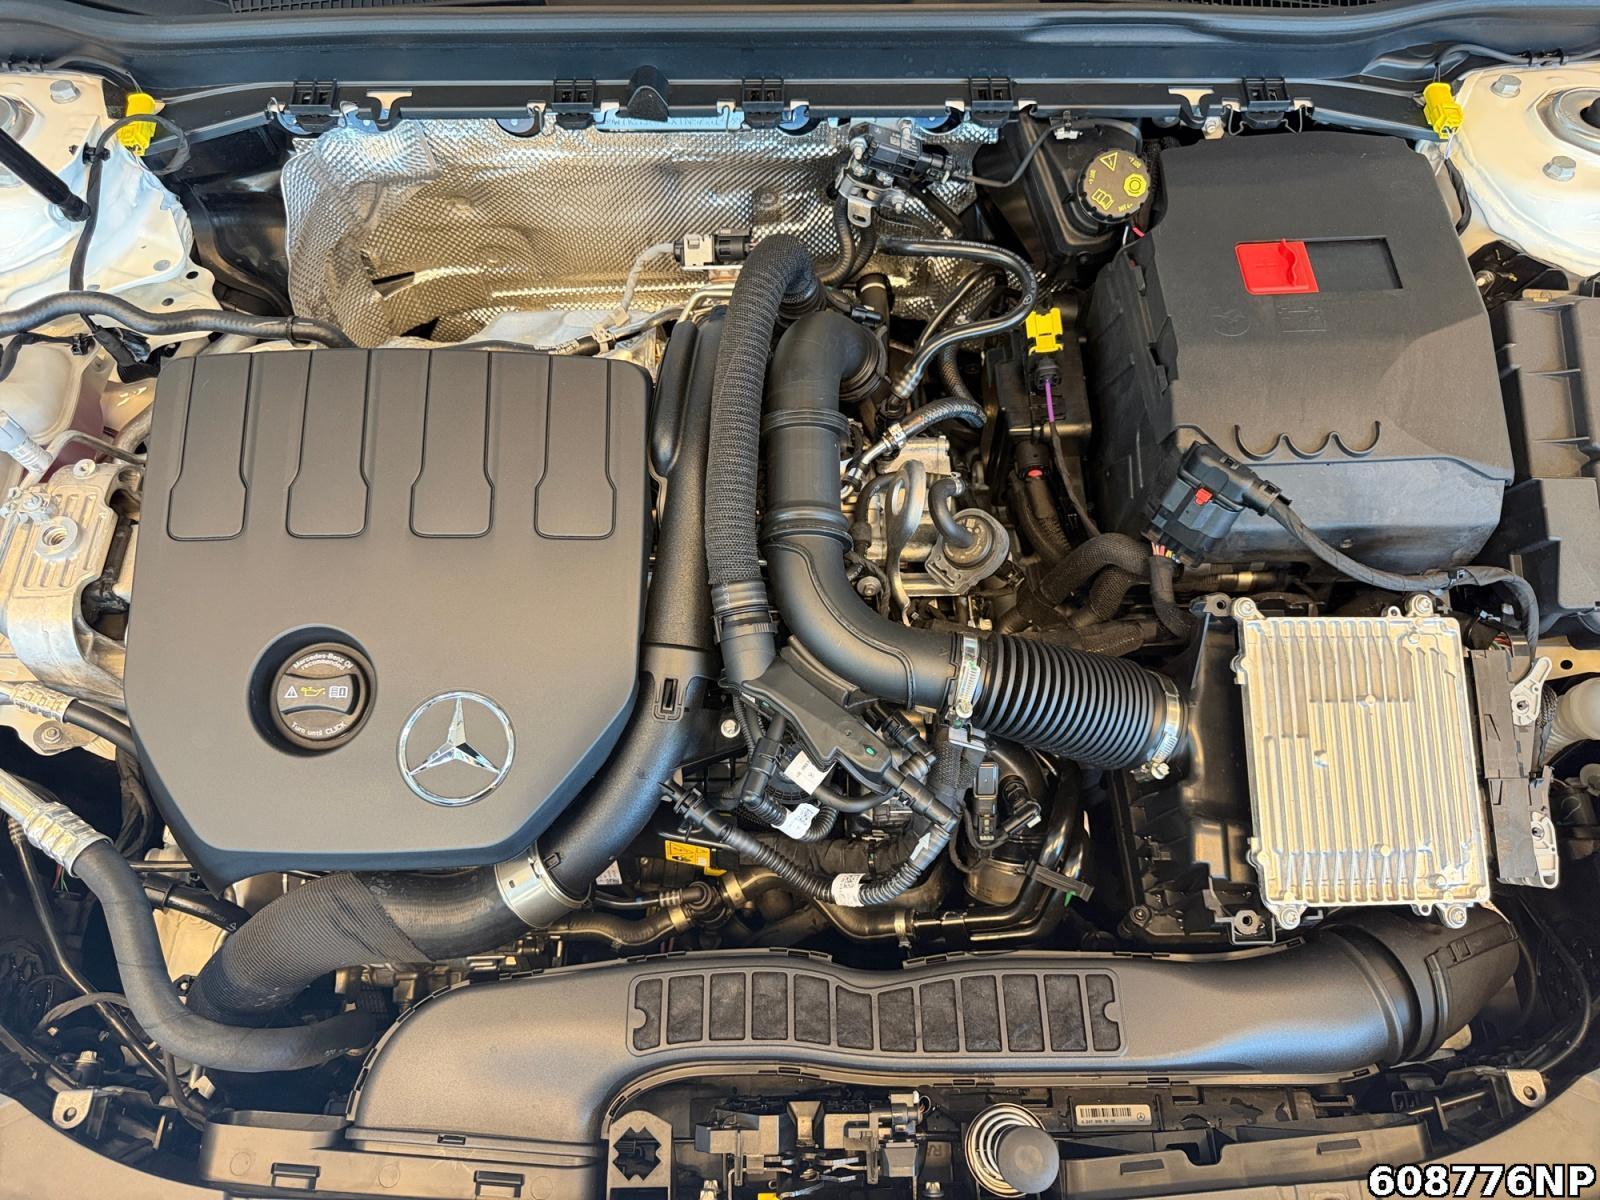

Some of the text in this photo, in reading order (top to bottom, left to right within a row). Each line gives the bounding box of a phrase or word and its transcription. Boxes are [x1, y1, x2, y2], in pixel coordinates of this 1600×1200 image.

[292, 653, 345, 669] Mercedes-Benz
[301, 659, 345, 670] recommended
[291, 721, 346, 737] Turn until CLICK
